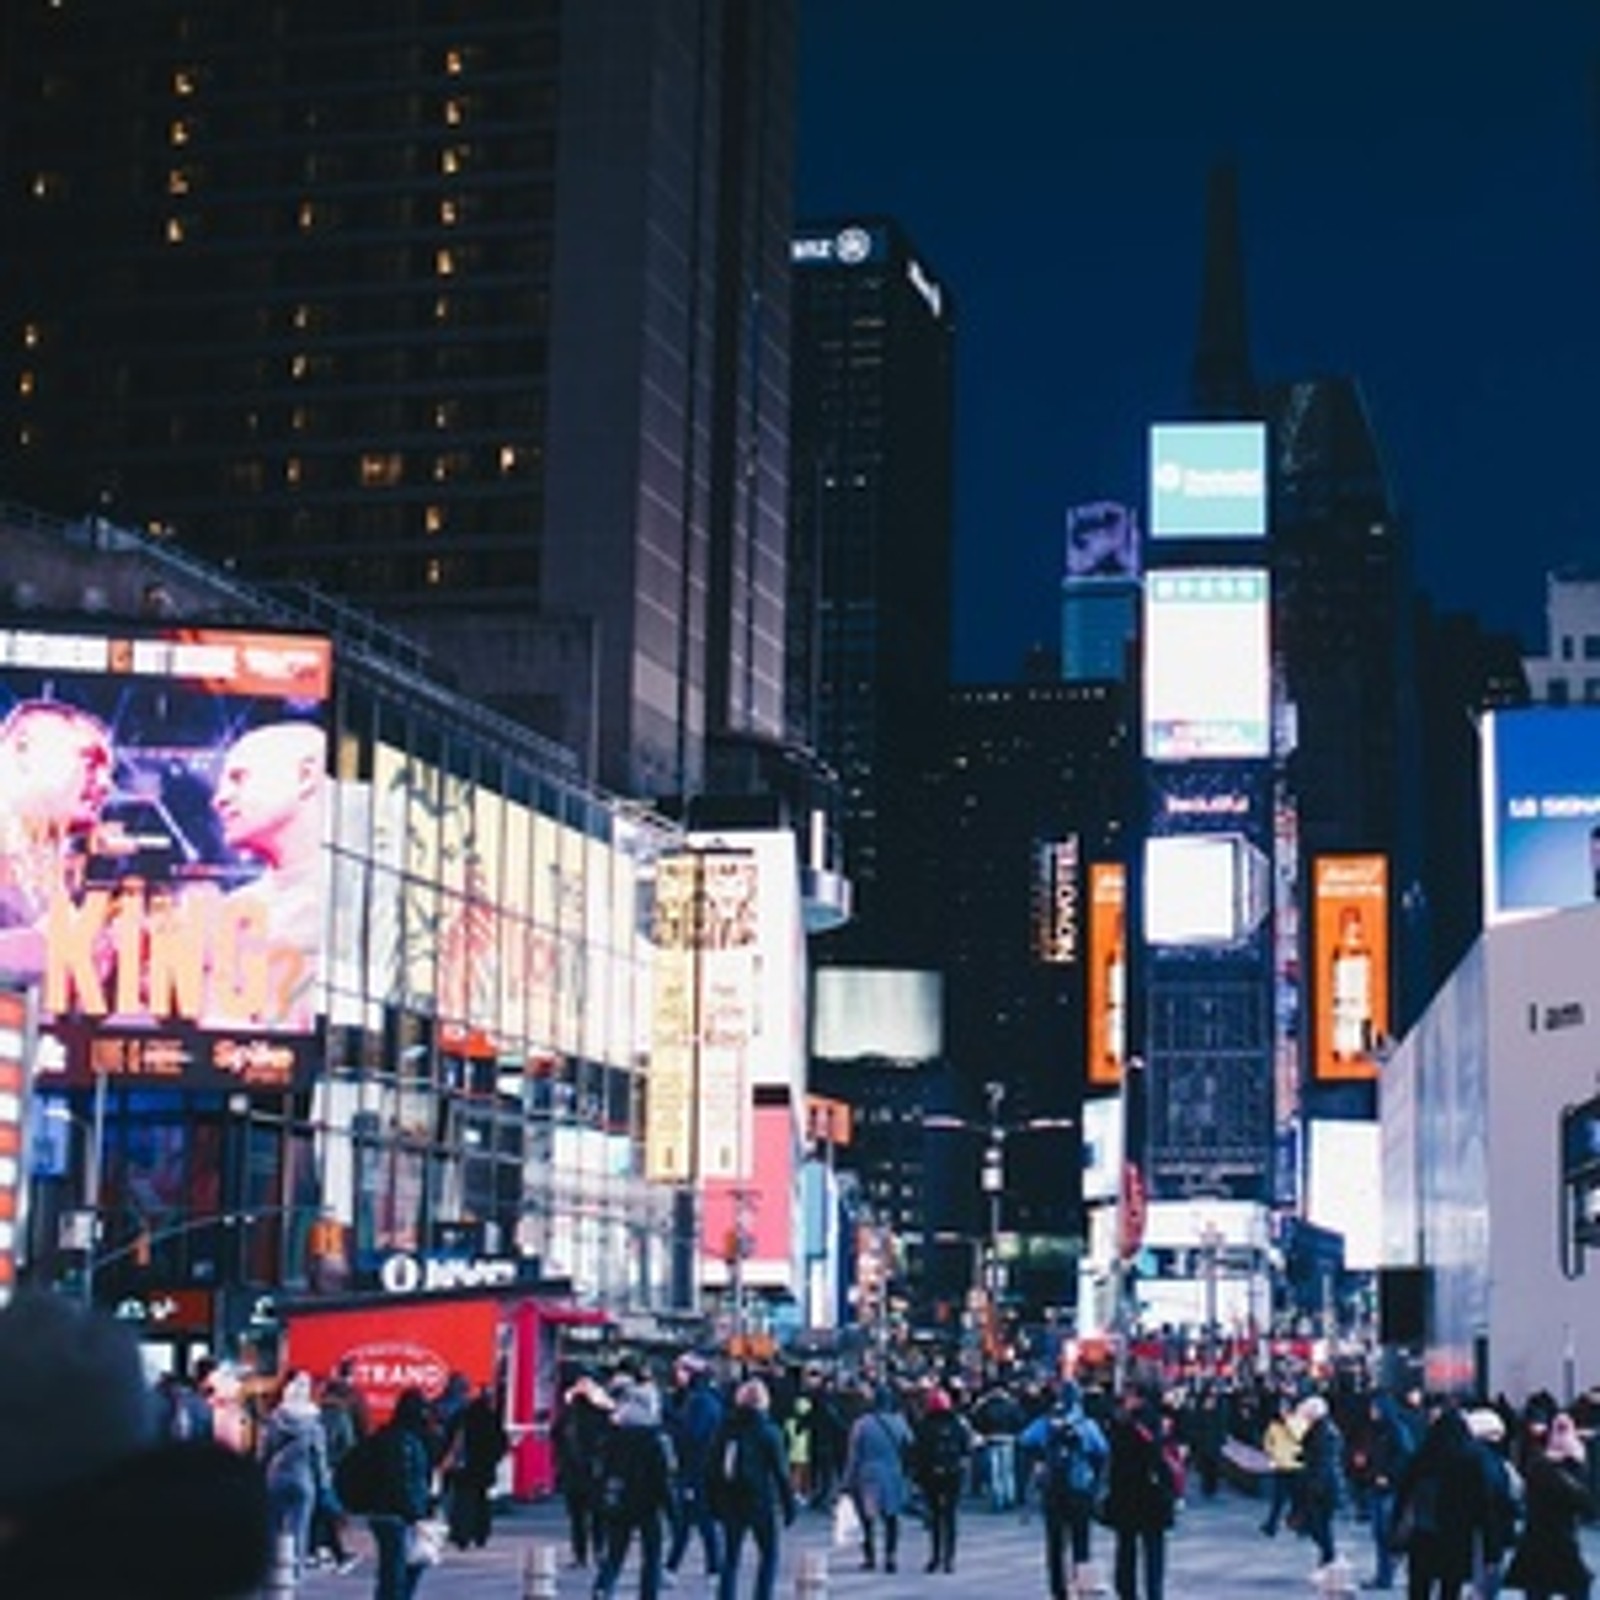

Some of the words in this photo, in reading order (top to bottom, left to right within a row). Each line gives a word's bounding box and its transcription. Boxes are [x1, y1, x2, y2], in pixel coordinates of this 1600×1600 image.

[1055, 832, 1080, 962] NOVOTEL
[1529, 1002, 1538, 1033] I
[1545, 1003, 1584, 1031] am
